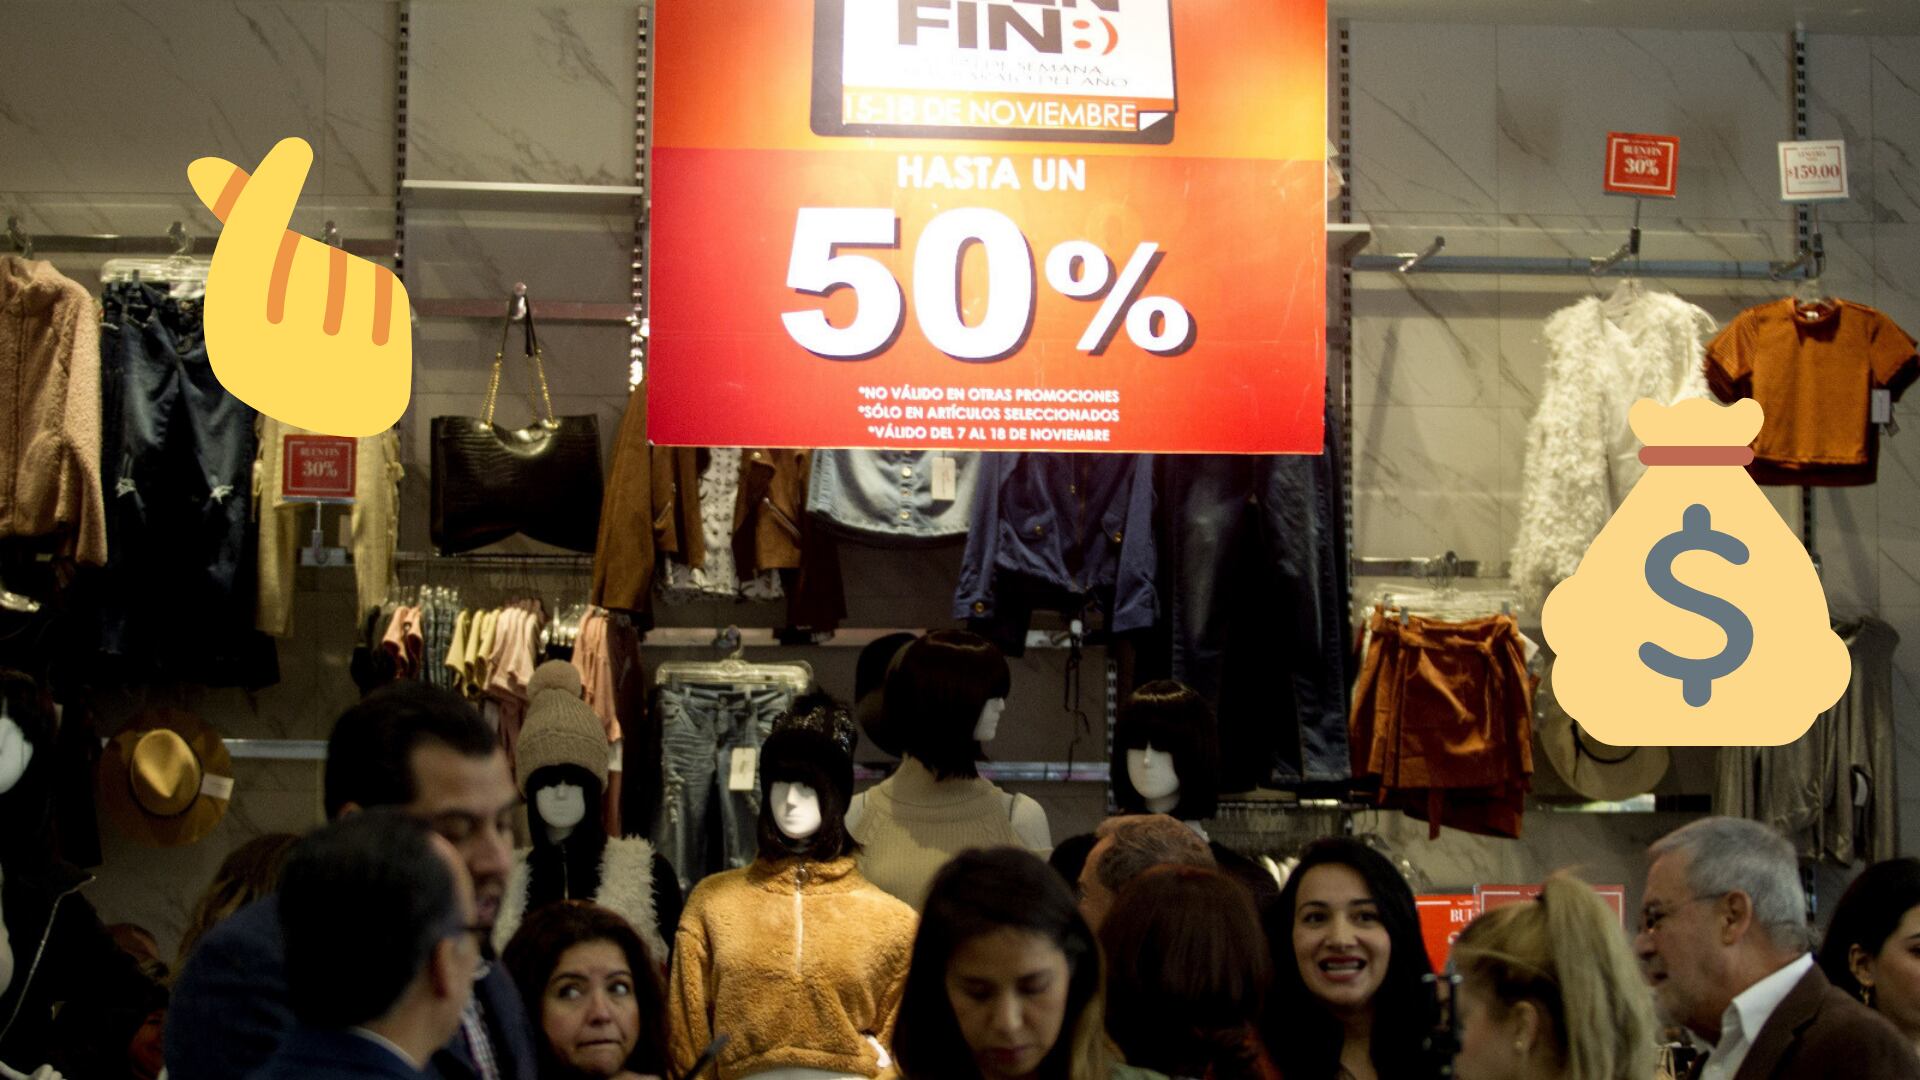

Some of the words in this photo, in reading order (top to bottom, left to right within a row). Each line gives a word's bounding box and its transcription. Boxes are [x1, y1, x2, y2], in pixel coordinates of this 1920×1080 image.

[898, 0, 1062, 54] FIN
[923, 97, 961, 126] DE
[970, 99, 1137, 130] NOVIEMBRE
[897, 155, 1019, 191] HASTA
[1033, 158, 1086, 192] UN
[1624, 158, 1660, 177] 30%
[780, 206, 1194, 362] 50%
[891, 383, 945, 401] VÁLIDO
[946, 387, 966, 401] EN
[967, 387, 1013, 402] OTRAS
[1015, 388, 1120, 403] PROMOCIONES
[905, 406, 924, 420] EN
[926, 403, 1001, 421] ARTÍCULOS
[1003, 407, 1120, 422] SELECCIONADOS
[930, 426, 955, 440] DEL
[957, 426, 967, 440] 7
[968, 426, 987, 441] AL
[990, 427, 1007, 441] 18
[1008, 427, 1028, 441] DE
[1030, 428, 1111, 442] NOVIEMBRE
[302, 460, 339, 478] 30%
